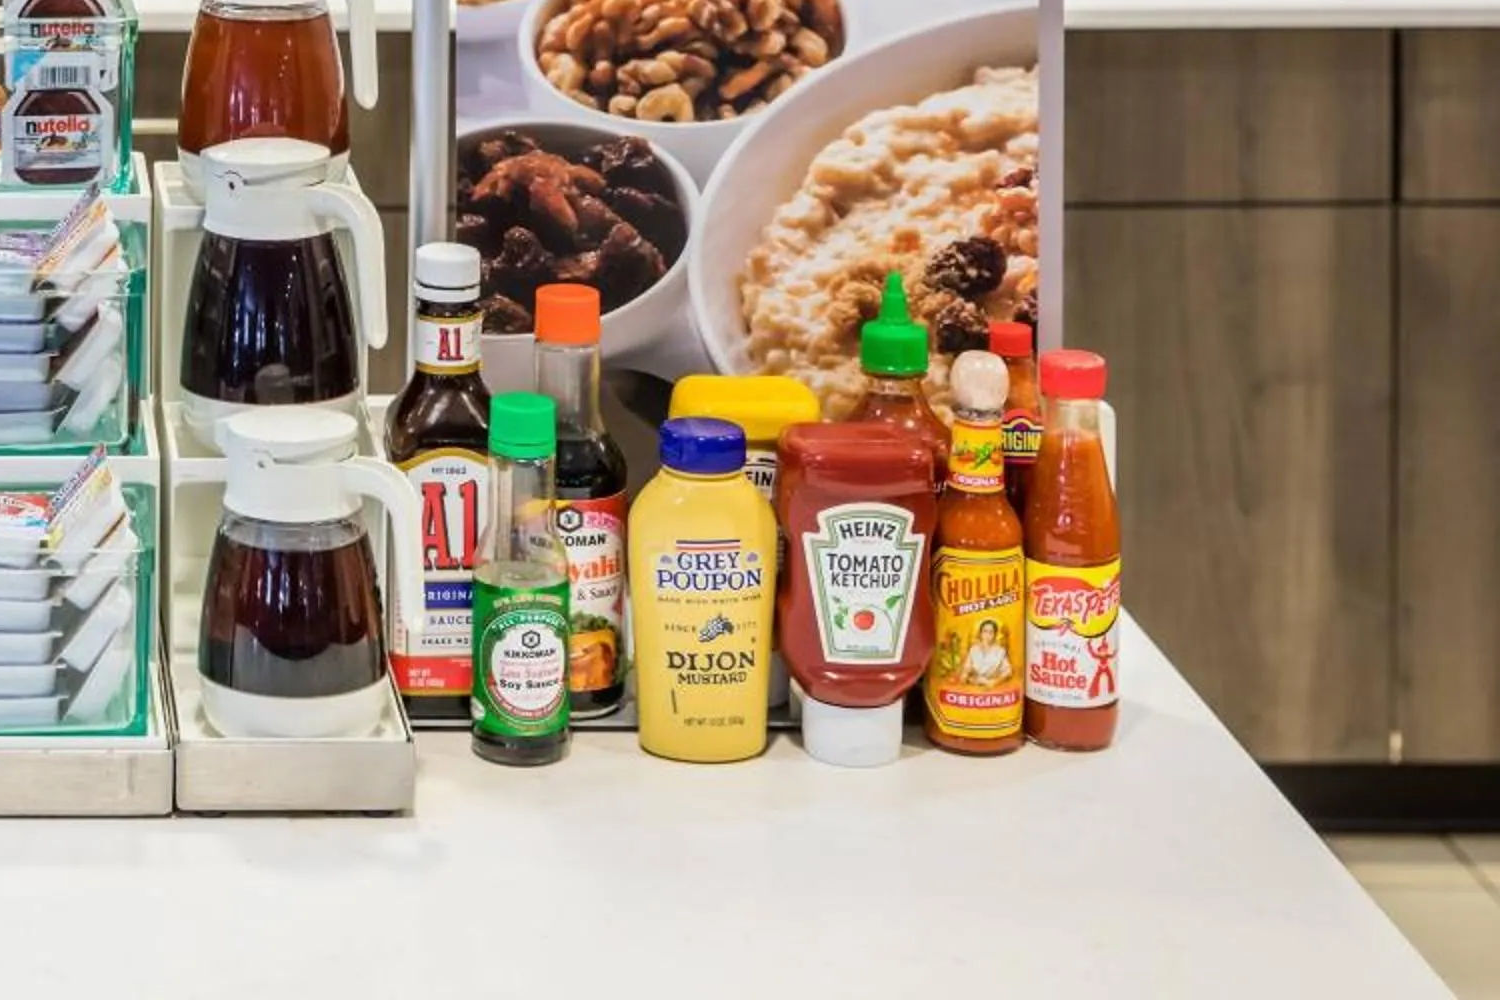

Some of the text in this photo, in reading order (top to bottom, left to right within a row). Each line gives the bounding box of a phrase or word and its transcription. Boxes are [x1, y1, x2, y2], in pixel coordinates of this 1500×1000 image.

[29, 22, 95, 38] nutella
[25, 114, 91, 135] nutella
[839, 520, 897, 541] HEINZ
[677, 551, 741, 571] GREY
[825, 553, 904, 574] TOMATO
[656, 568, 762, 591] POUPON
[830, 573, 901, 589] KETCHUP
[937, 567, 1020, 612] CHOLULA
[1032, 585, 1084, 617] TEXAS
[666, 650, 755, 672] DIJON
[1041, 650, 1077, 674] Hot
[500, 677, 560, 690] Soy Sauce
[677, 671, 747, 685] MUSTARD
[1029, 663, 1088, 689] Sauce
[944, 692, 1017, 708] ORIGINAL
